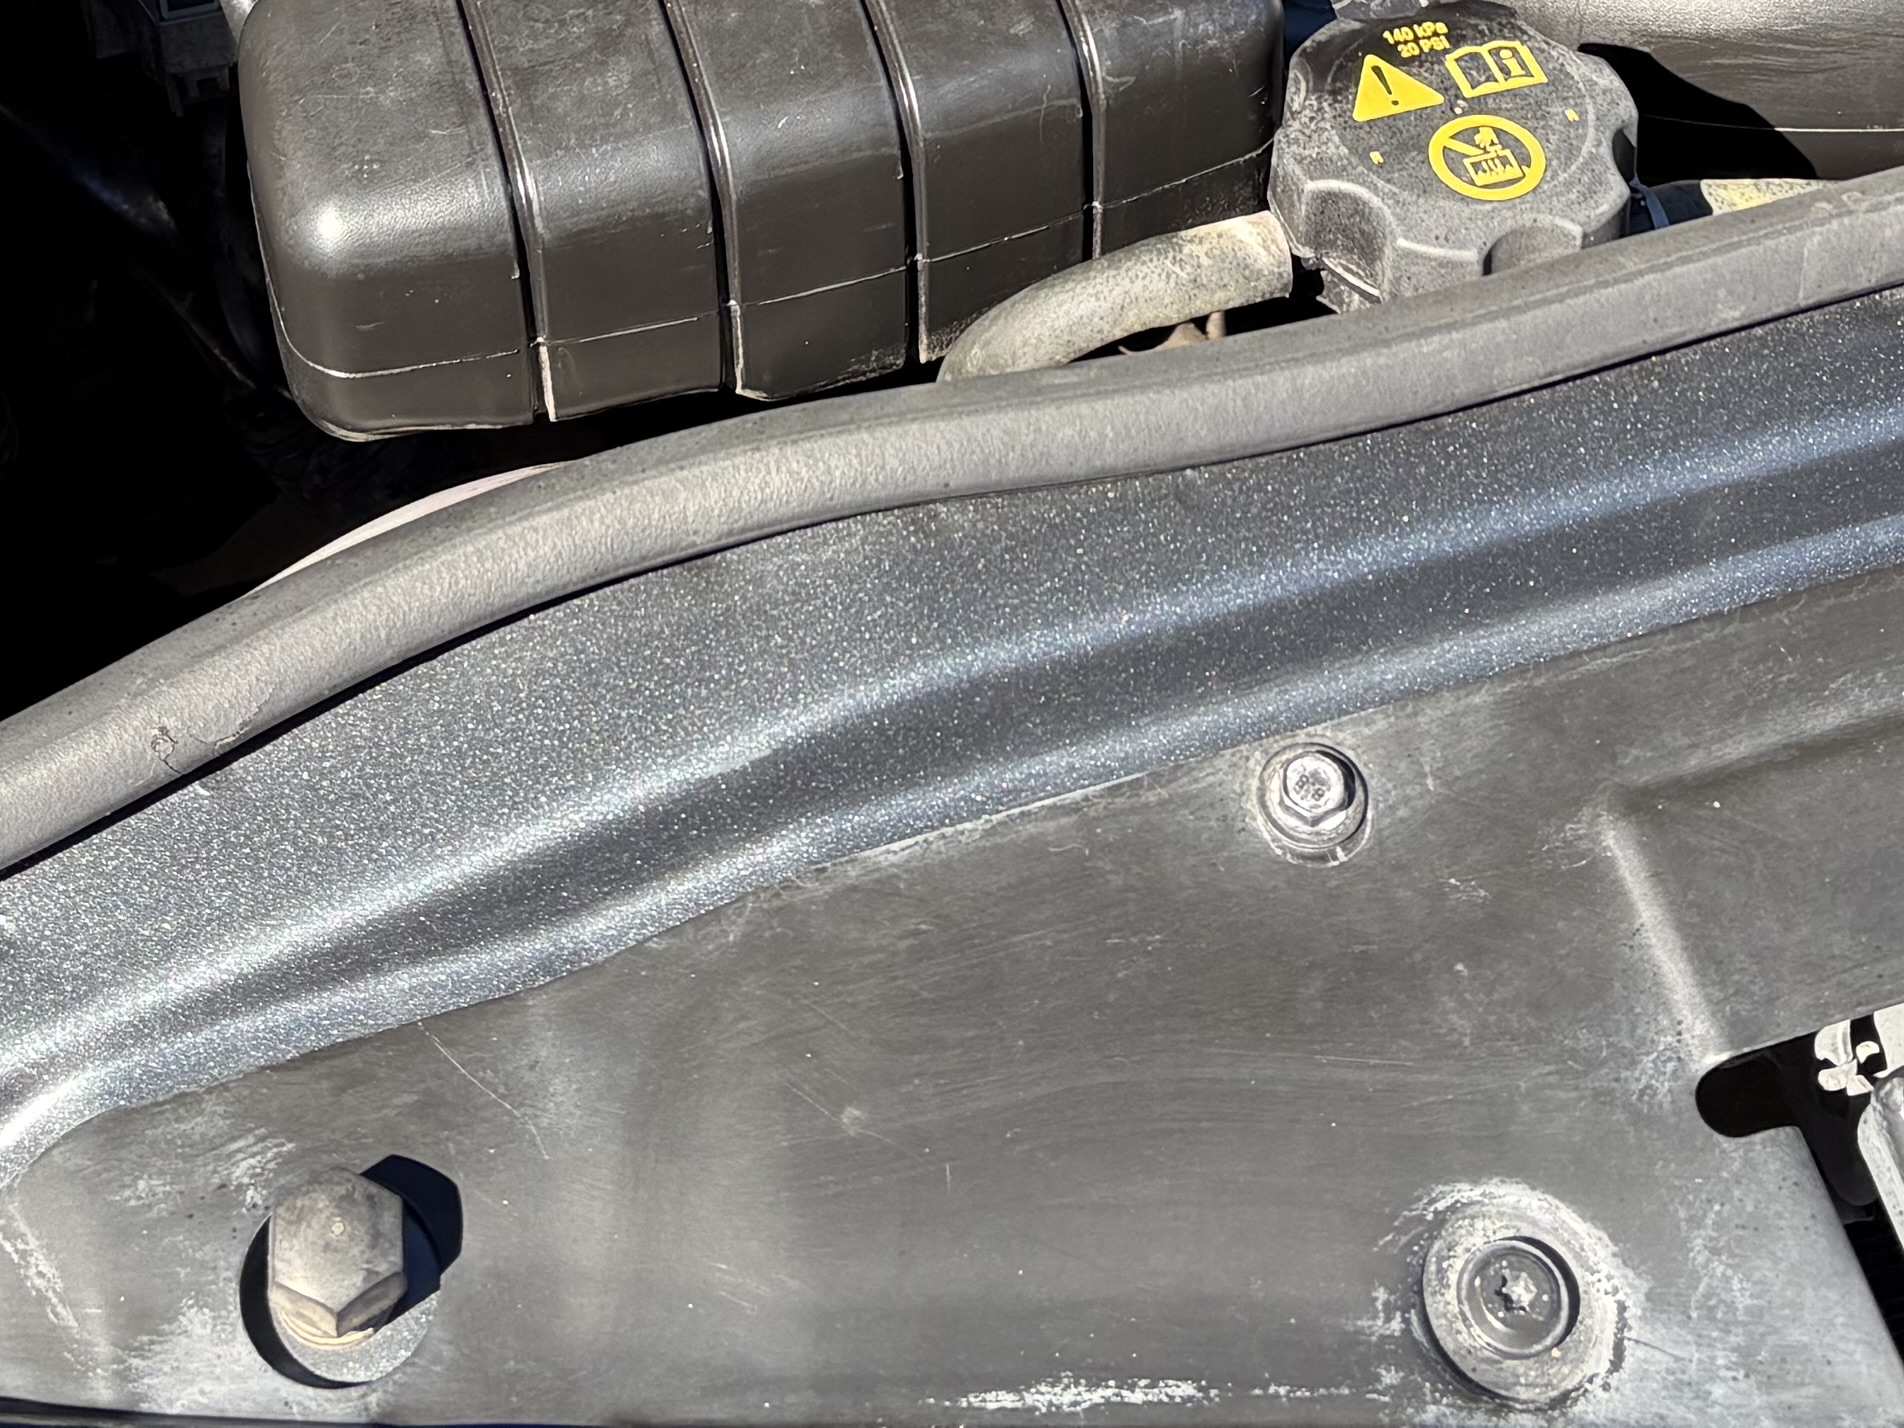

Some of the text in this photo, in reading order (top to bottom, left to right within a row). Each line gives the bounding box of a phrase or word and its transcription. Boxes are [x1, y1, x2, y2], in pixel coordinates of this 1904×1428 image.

[1382, 21, 1449, 45] 140 kPa
[1397, 35, 1451, 58] 20 PSI
